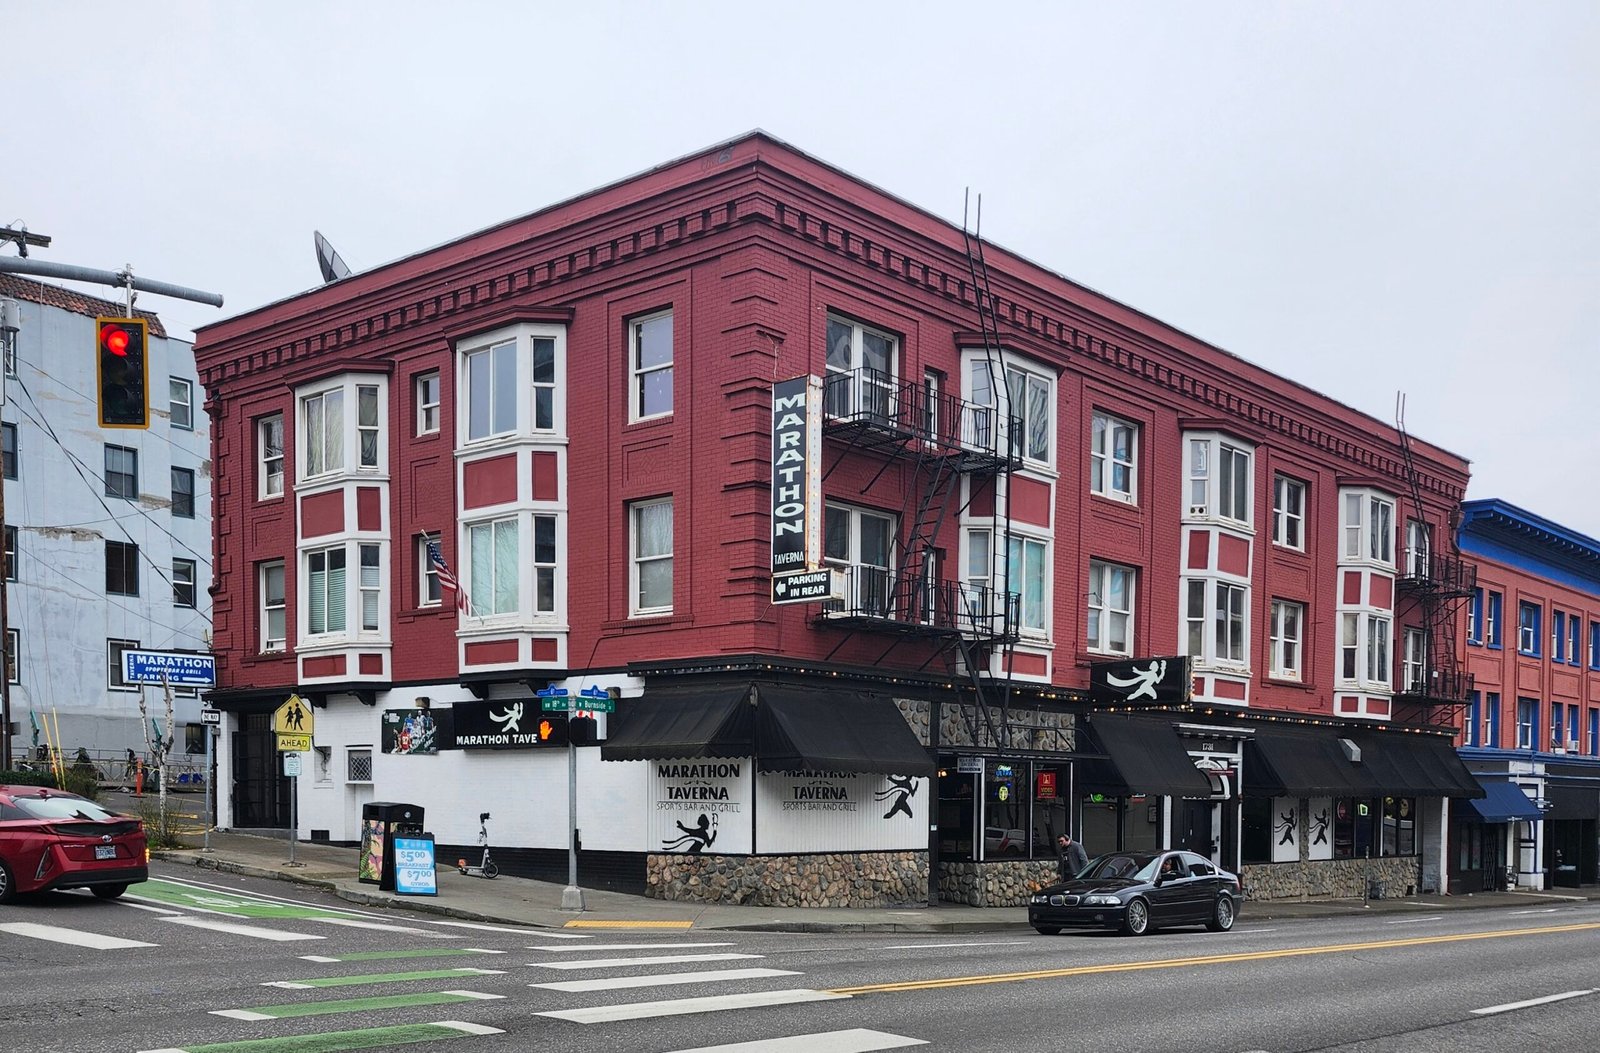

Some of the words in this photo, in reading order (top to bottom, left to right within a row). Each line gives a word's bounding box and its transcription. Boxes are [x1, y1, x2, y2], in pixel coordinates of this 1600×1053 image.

[775, 392, 806, 537] MARATHON
[774, 551, 804, 565] TAVERNA
[788, 573, 827, 586] PARKING
[790, 588, 800, 597] IN
[801, 585, 825, 596] REAR
[136, 655, 212, 669] MARATHON
[584, 700, 606, 710] Burnside
[280, 739, 308, 748] AHEAD
[456, 734, 509, 745] MARATHON
[658, 764, 740, 778] MARATHON
[667, 786, 729, 800] TAVERNA
[792, 786, 848, 800] TAVERNA
[656, 802, 682, 811] SPORTS
[683, 803, 698, 811] BAR
[699, 803, 717, 812] AND
[718, 804, 741, 813] GRILL
[782, 802, 807, 811] SPORTS
[808, 802, 821, 811] BAR
[822, 802, 838, 811] AND
[838, 802, 857, 812] GRILL
